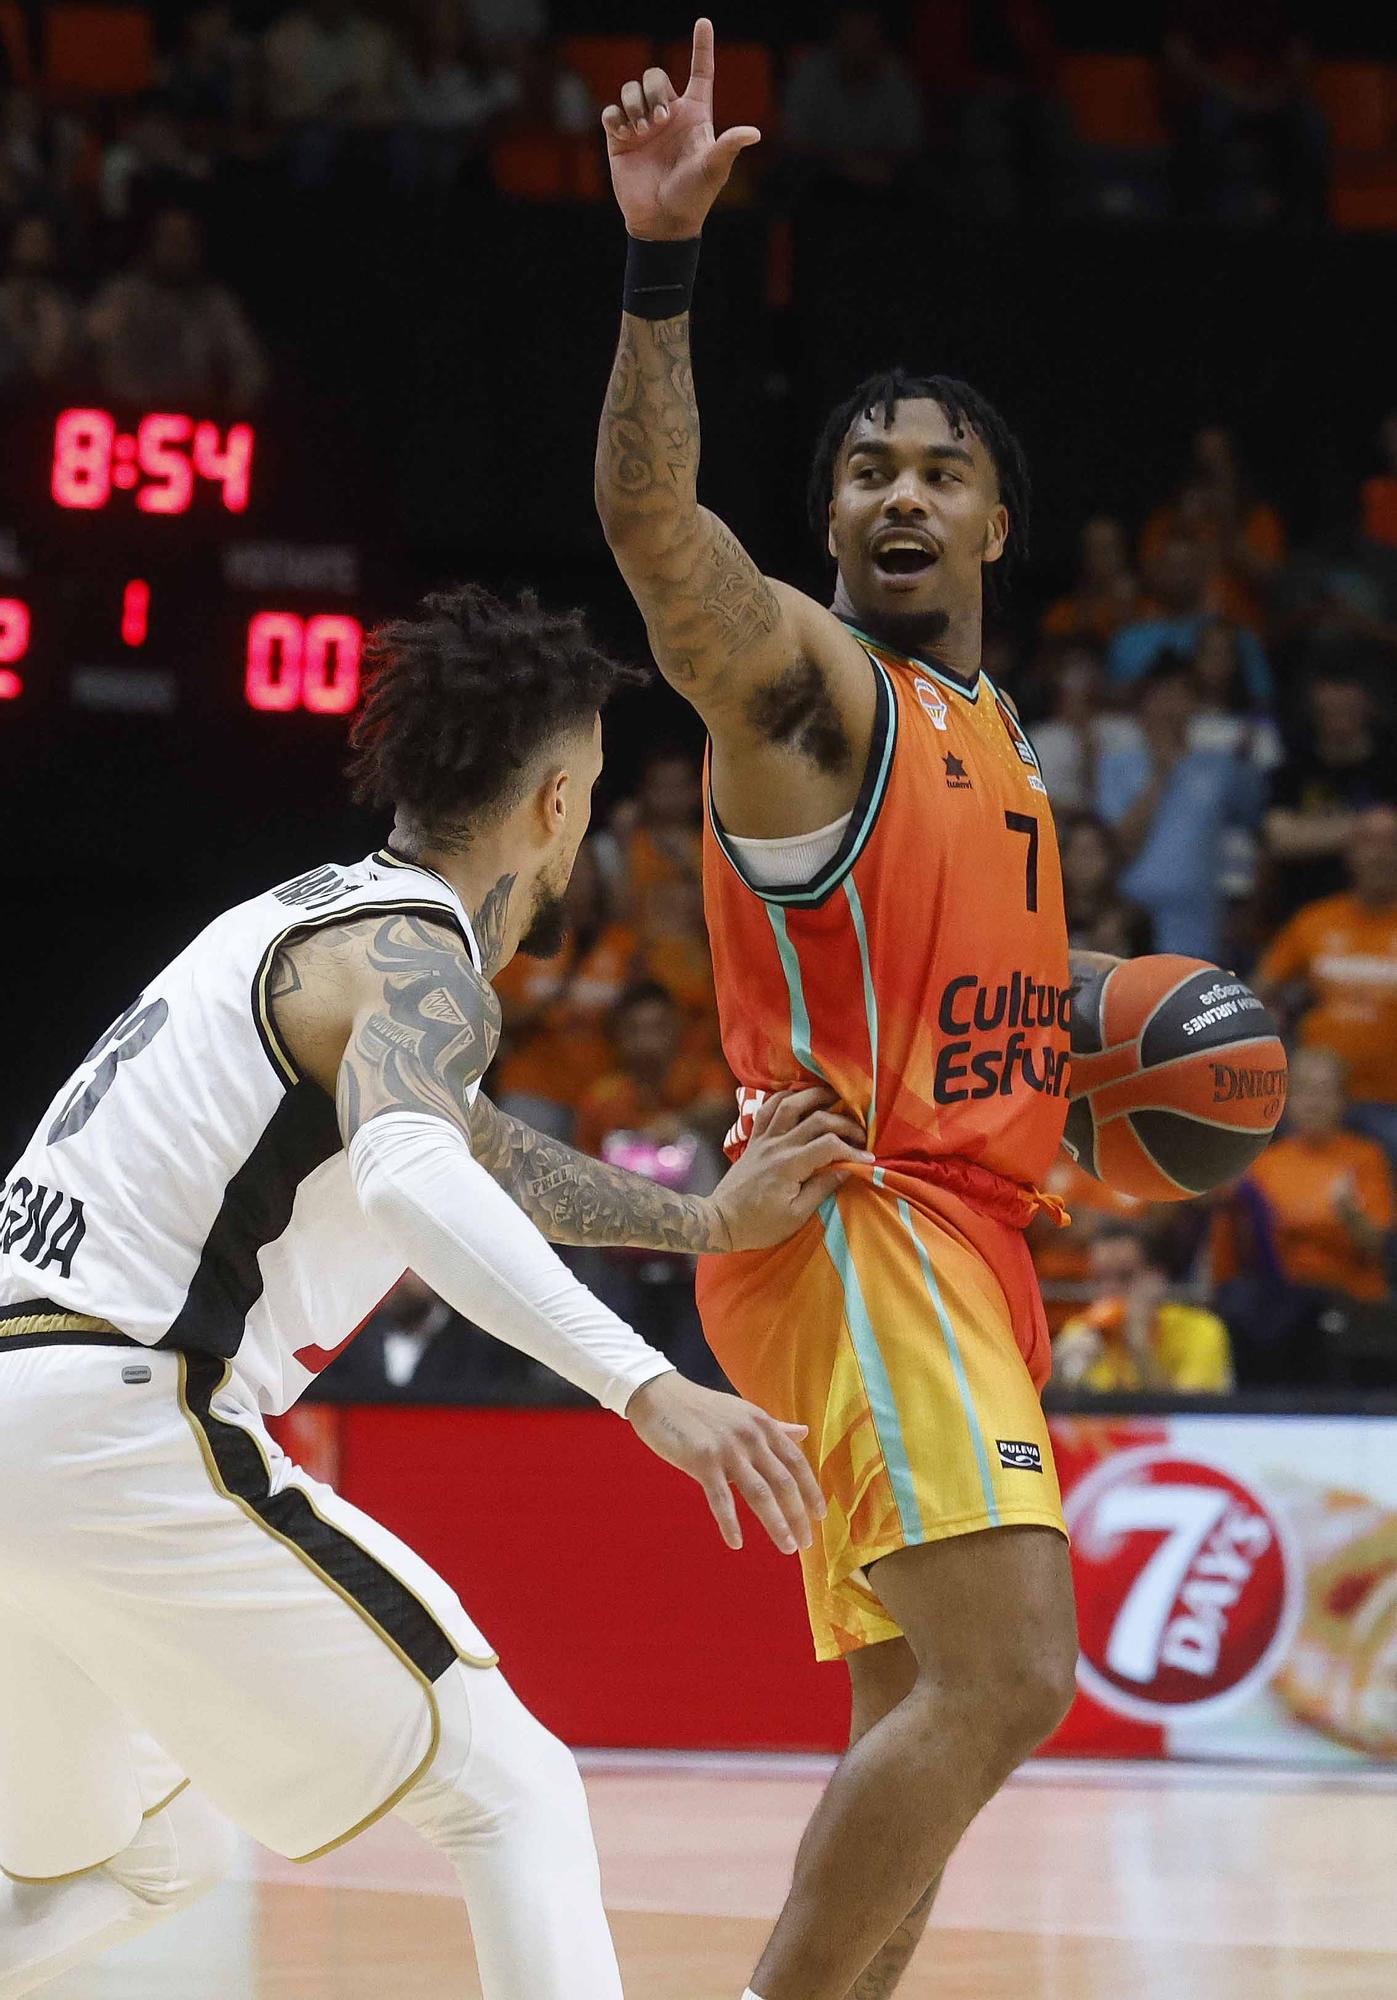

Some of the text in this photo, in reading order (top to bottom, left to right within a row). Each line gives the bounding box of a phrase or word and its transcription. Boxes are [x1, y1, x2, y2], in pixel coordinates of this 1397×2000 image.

[53, 407, 254, 514] 8:54
[121, 579, 149, 647] 1
[246, 611, 361, 714] 00
[1004, 810, 1038, 913] 7
[1182, 1000, 1238, 1036] AIRLINES
[999, 1442, 1038, 1457] PULEVA
[1096, 1484, 1272, 1684] 7 DAYS
